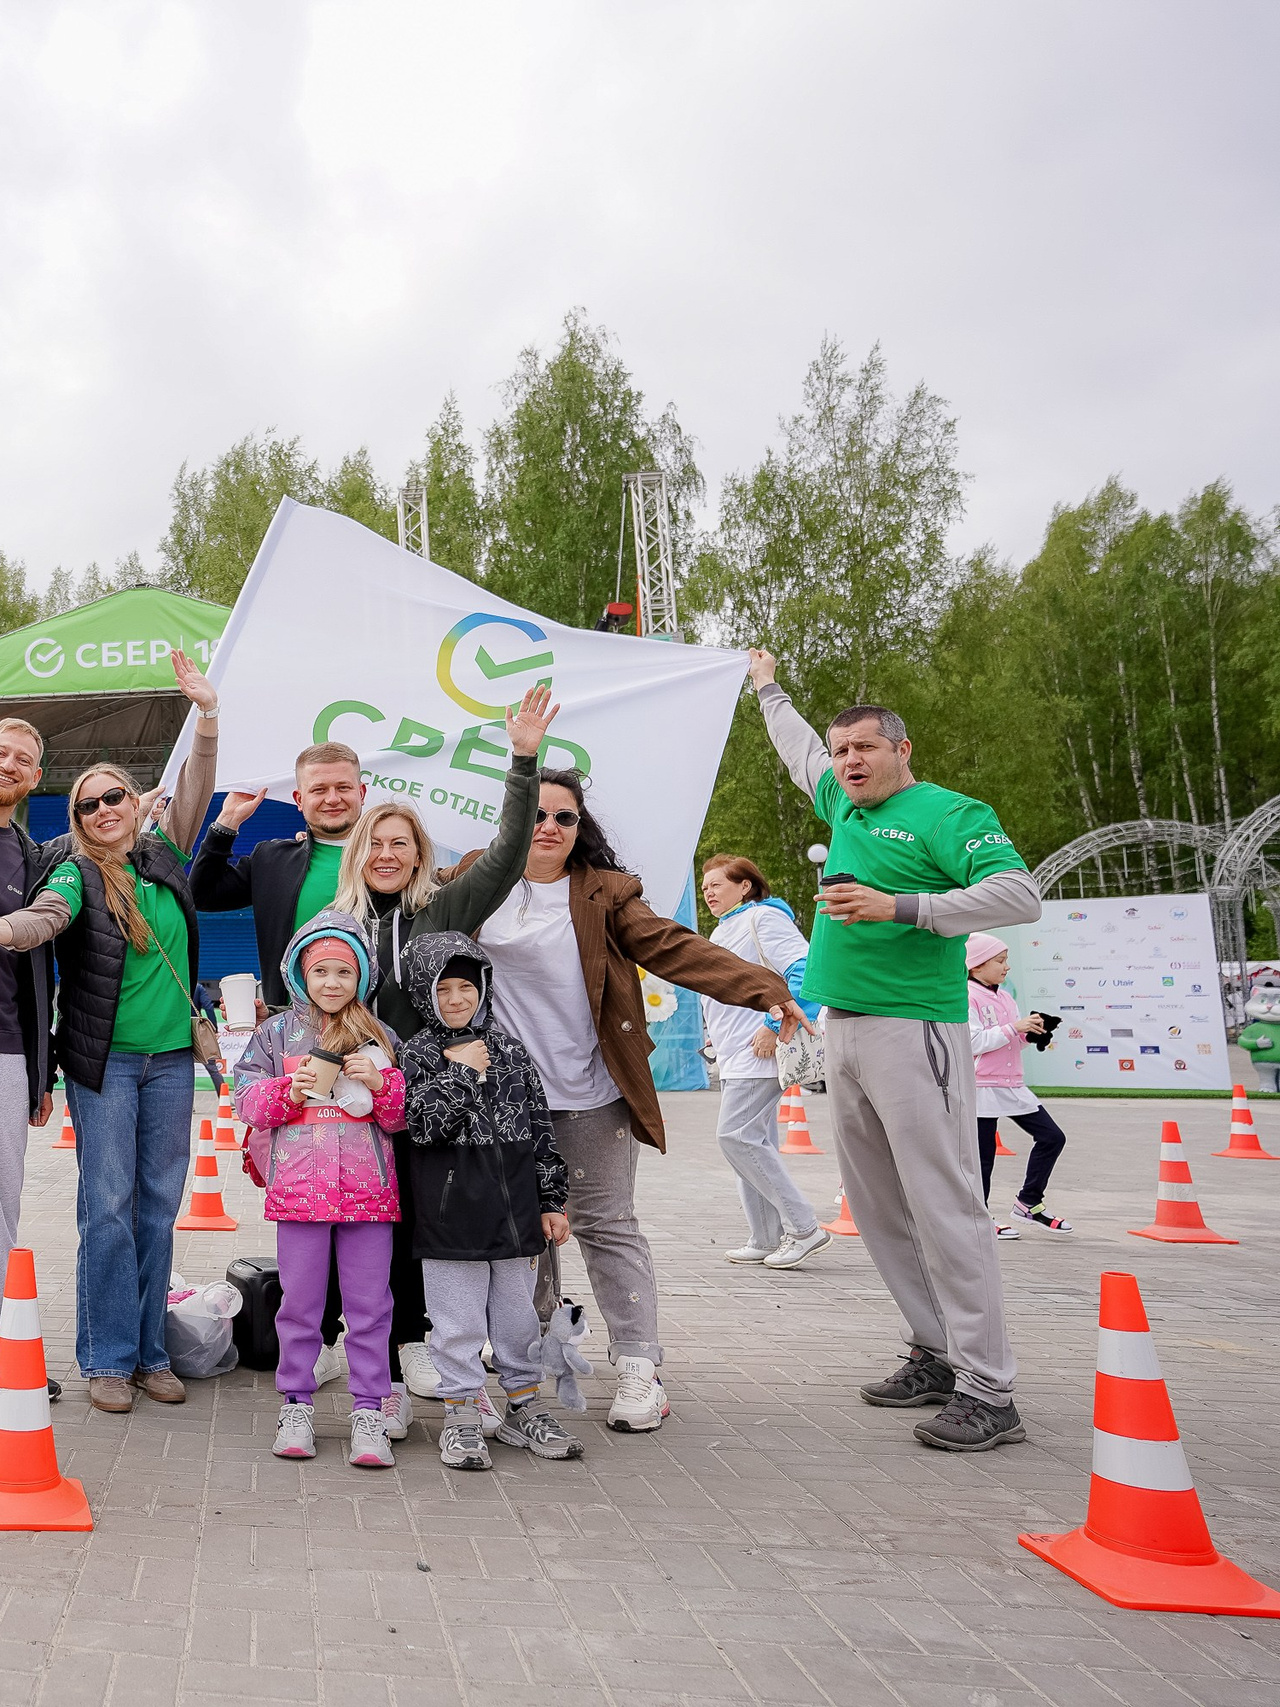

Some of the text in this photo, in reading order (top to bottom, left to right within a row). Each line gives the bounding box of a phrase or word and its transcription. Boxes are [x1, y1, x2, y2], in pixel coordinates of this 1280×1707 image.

[75, 639, 170, 668] СБЕР
[881, 828, 916, 842] СБЕР
[984, 834, 1013, 845] СБЕ
[49, 875, 76, 884] БЕР
[1112, 979, 1134, 987] Utair
